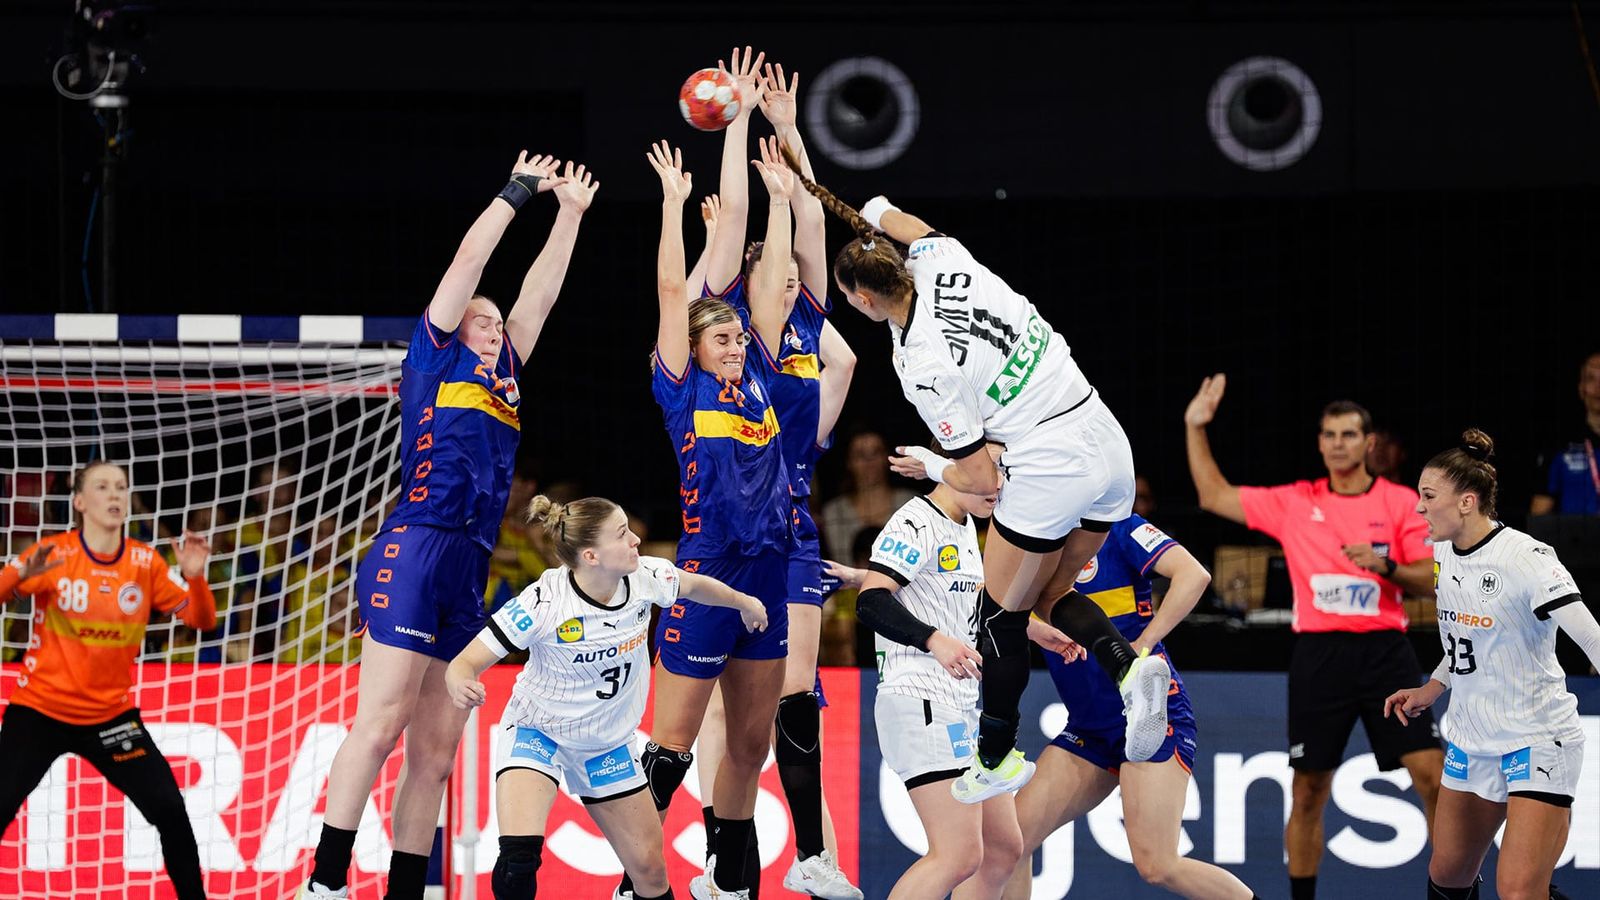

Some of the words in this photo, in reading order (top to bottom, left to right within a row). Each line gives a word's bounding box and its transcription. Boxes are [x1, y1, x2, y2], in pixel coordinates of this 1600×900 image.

[879, 536, 921, 565] DKB
[57, 577, 89, 613] 38
[1346, 582, 1376, 609] TV
[1447, 632, 1477, 675] 33
[596, 662, 632, 699] 31
